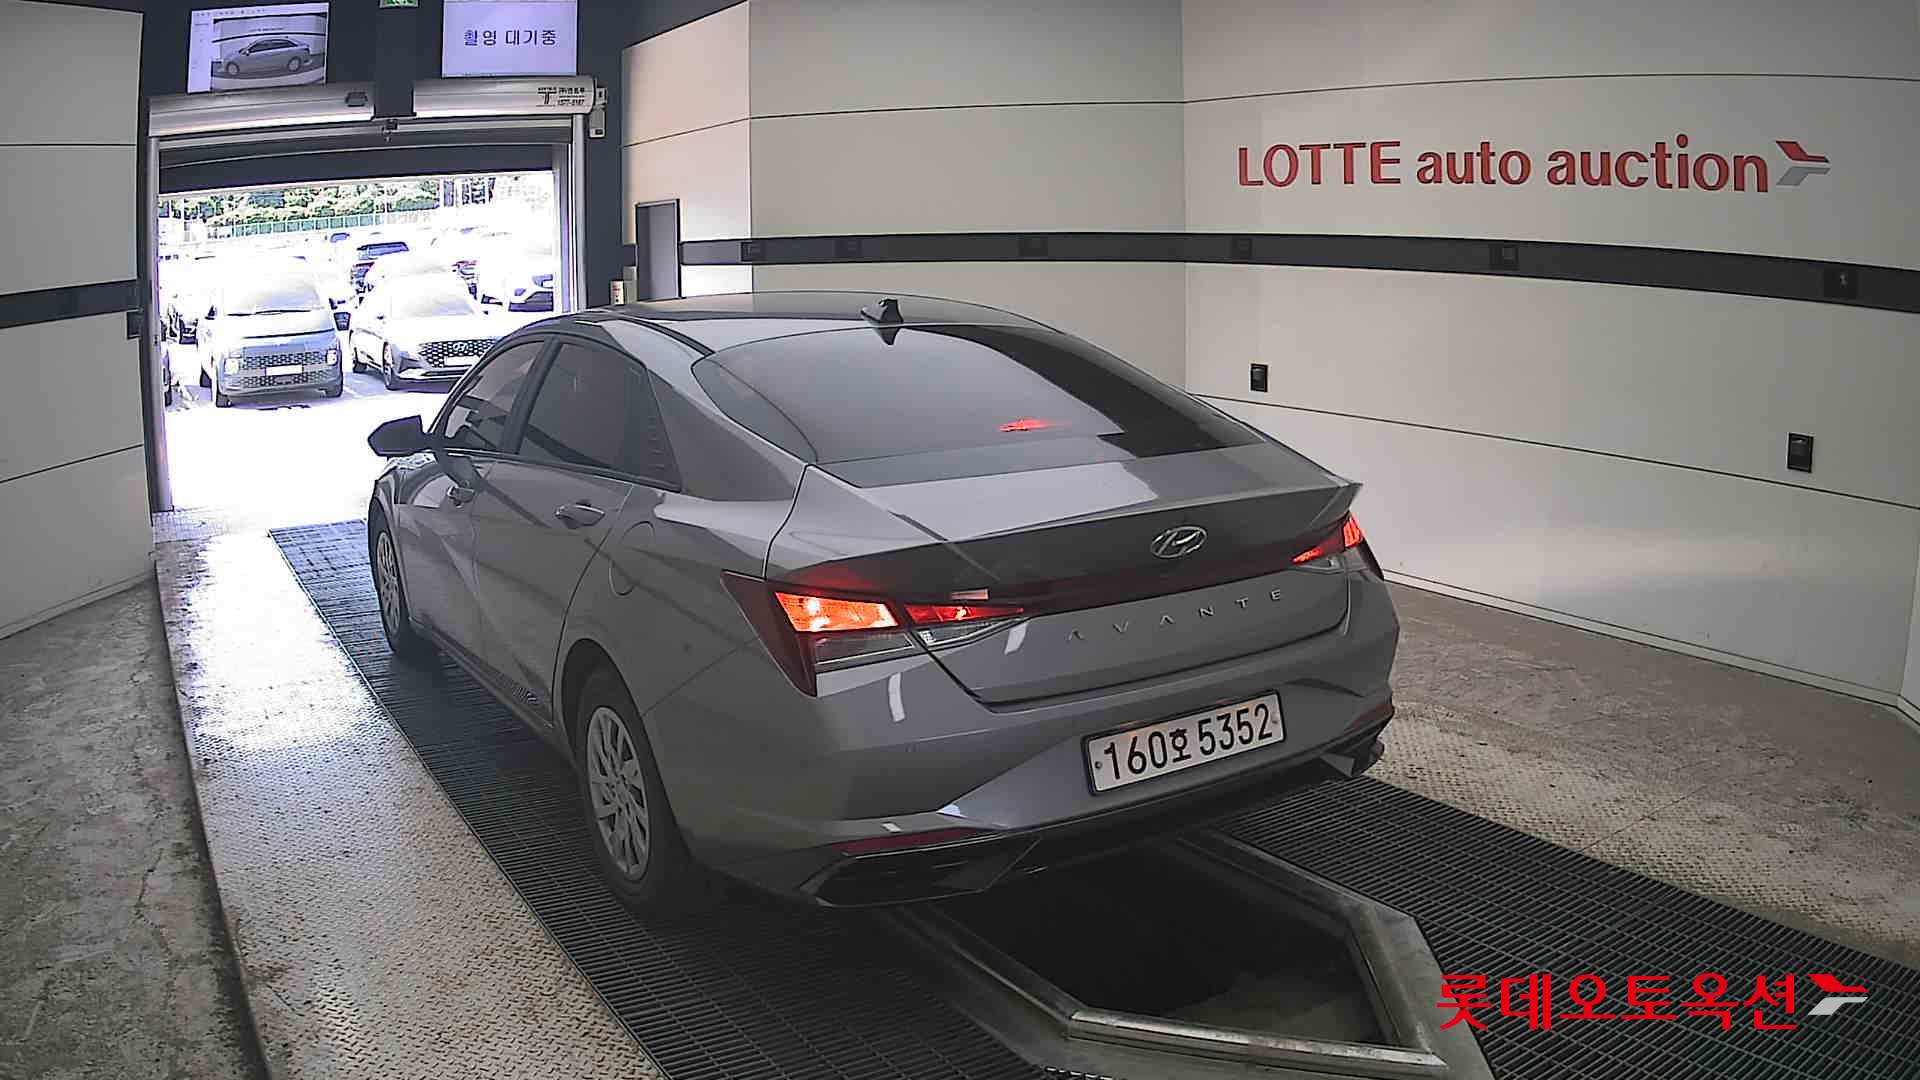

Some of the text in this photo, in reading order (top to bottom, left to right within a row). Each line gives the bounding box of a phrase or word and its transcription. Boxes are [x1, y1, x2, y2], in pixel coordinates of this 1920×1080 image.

[505, 29, 557, 46] 대기중
[1238, 135, 1769, 192] LOTTE auto auction
[1065, 588, 1281, 642] AVANTE
[1103, 703, 1273, 780] 160호 5352
